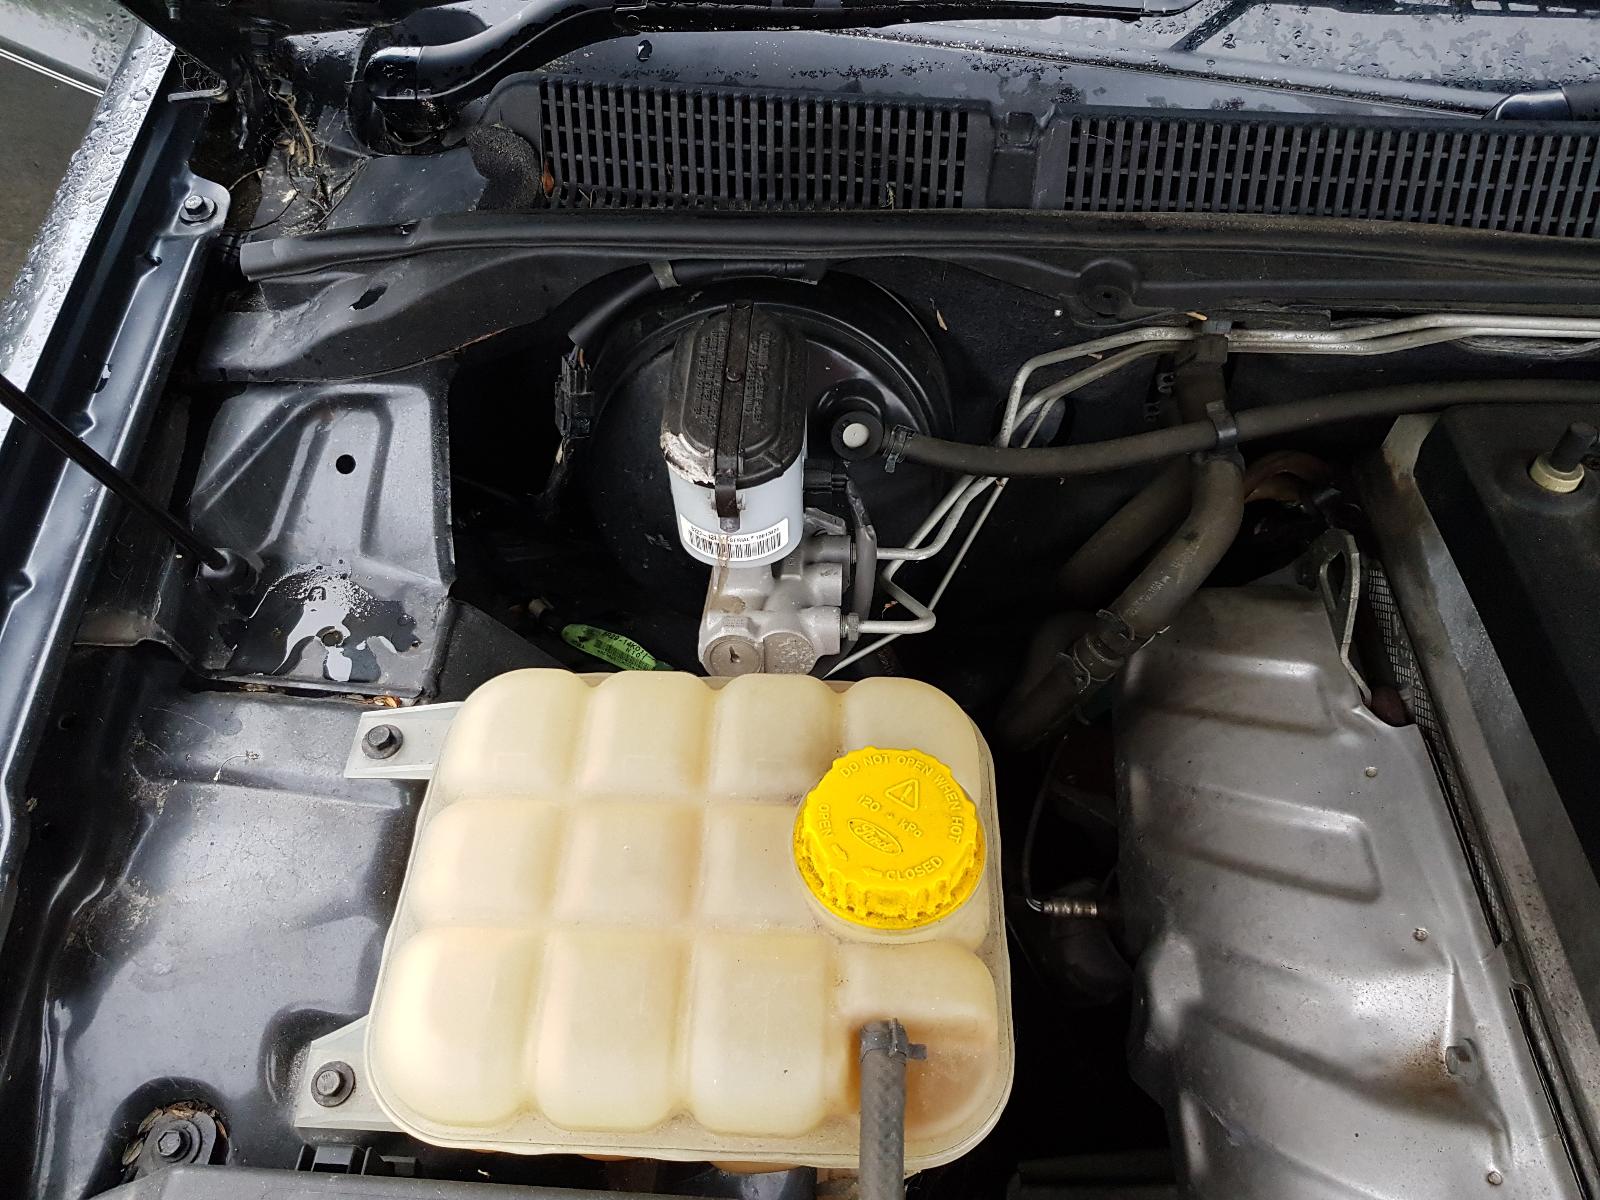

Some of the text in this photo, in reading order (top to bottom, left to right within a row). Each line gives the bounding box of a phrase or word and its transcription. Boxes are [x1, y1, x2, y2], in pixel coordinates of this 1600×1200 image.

[857, 794, 881, 812] 120
[864, 754, 890, 767] NOT
[896, 755, 934, 777] OPEN
[934, 773, 962, 811] WHEN
[949, 815, 965, 844] HOT
[818, 804, 832, 838] OPEN
[854, 823, 894, 853] Ford
[886, 855, 944, 881] CLOSED
